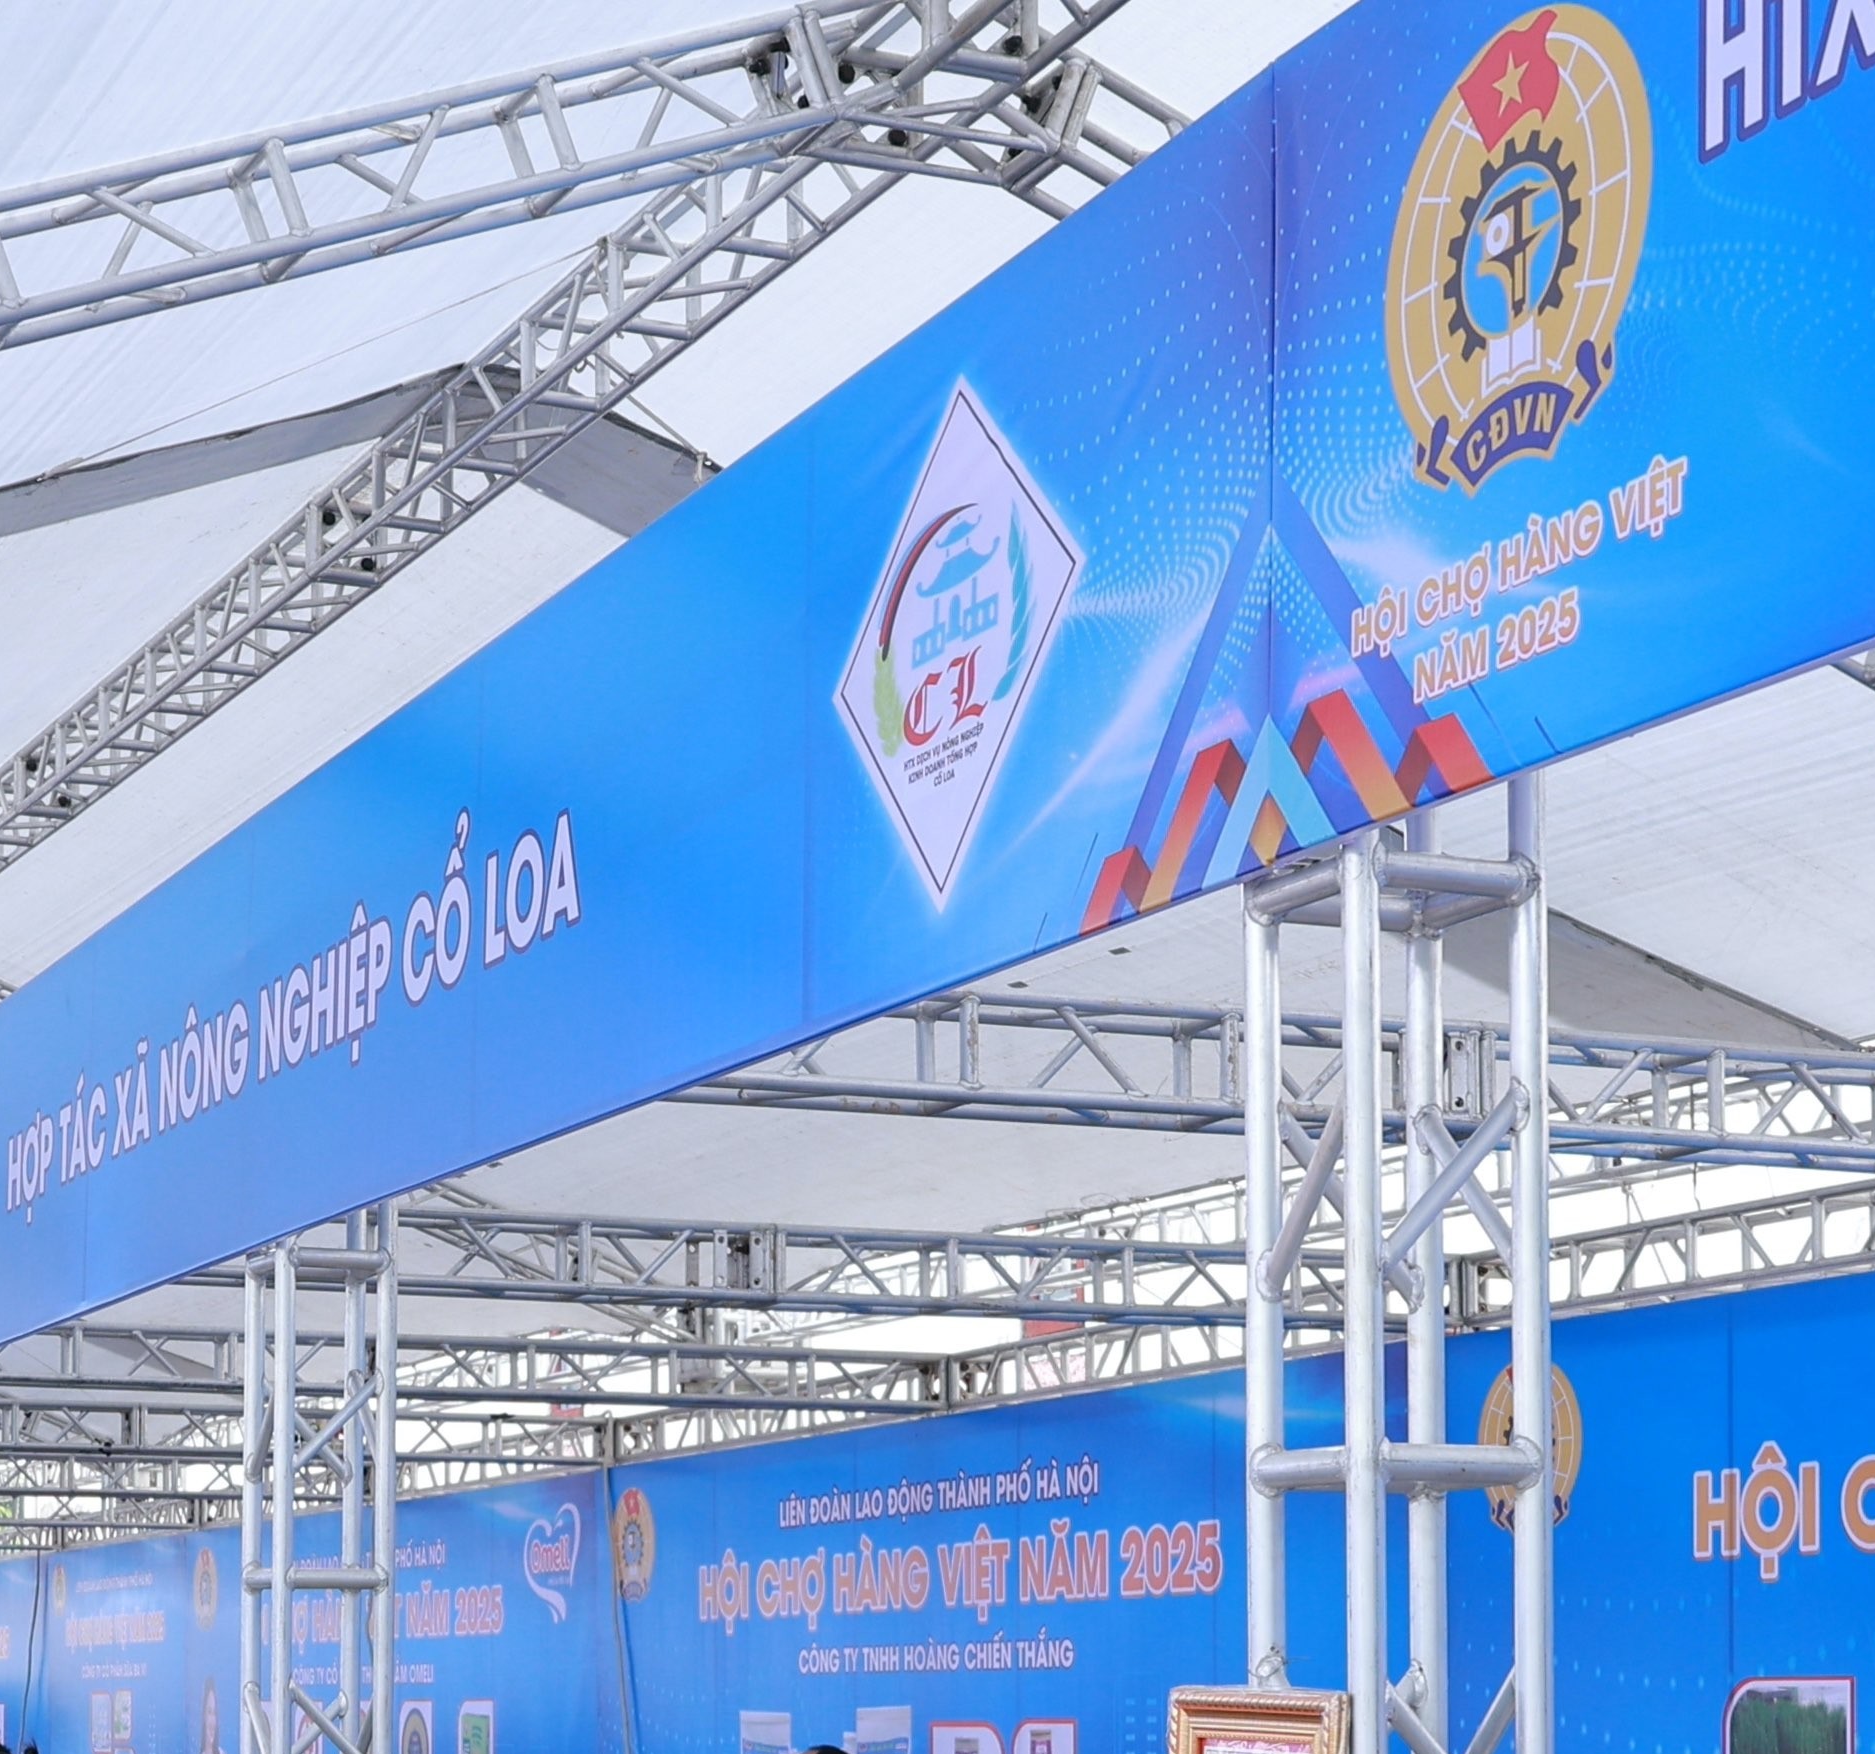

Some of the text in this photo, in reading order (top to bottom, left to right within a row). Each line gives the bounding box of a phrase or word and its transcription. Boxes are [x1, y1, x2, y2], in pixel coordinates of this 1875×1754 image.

[1465, 390, 1559, 472] CĐVN
[1351, 454, 1688, 658] HỘI CHỢ HÀNG VIỆT
[1414, 587, 1579, 703] NĂM 2025
[904, 758, 916, 772] HTX
[916, 750, 932, 767] DỊCH
[941, 735, 959, 753] NÔNG
[960, 721, 984, 744] NGHIỆP
[908, 741, 978, 784] KINH DOANH TỔNG HỢP
[933, 769, 956, 787] CỔ LOA
[6, 806, 582, 1224] HỢP TÁC XÃ NÔNG NGHIỆP CỔ LOA
[779, 1453, 1100, 1529] LIÊN ĐOÀN LAO ĐỘNG THÀNH PHỐ HÀ NỘI
[1692, 1440, 1821, 1584] HỘI
[415, 1540, 428, 1567] HÀ
[428, 1539, 445, 1570] NỘI
[531, 1533, 570, 1574] Omeli
[698, 1517, 1224, 1636] HỘI CHỢ HÀNG VIỆT NĂM 2025
[406, 1579, 450, 1638] NĂM
[453, 1584, 504, 1636] 2025
[293, 1663, 315, 1686] CÔNG
[315, 1666, 325, 1684] TY
[408, 1663, 435, 1684] OMELI
[798, 1625, 1074, 1676] CÔNG TY TNHH HOÀNG CHIẾN THẮNG
